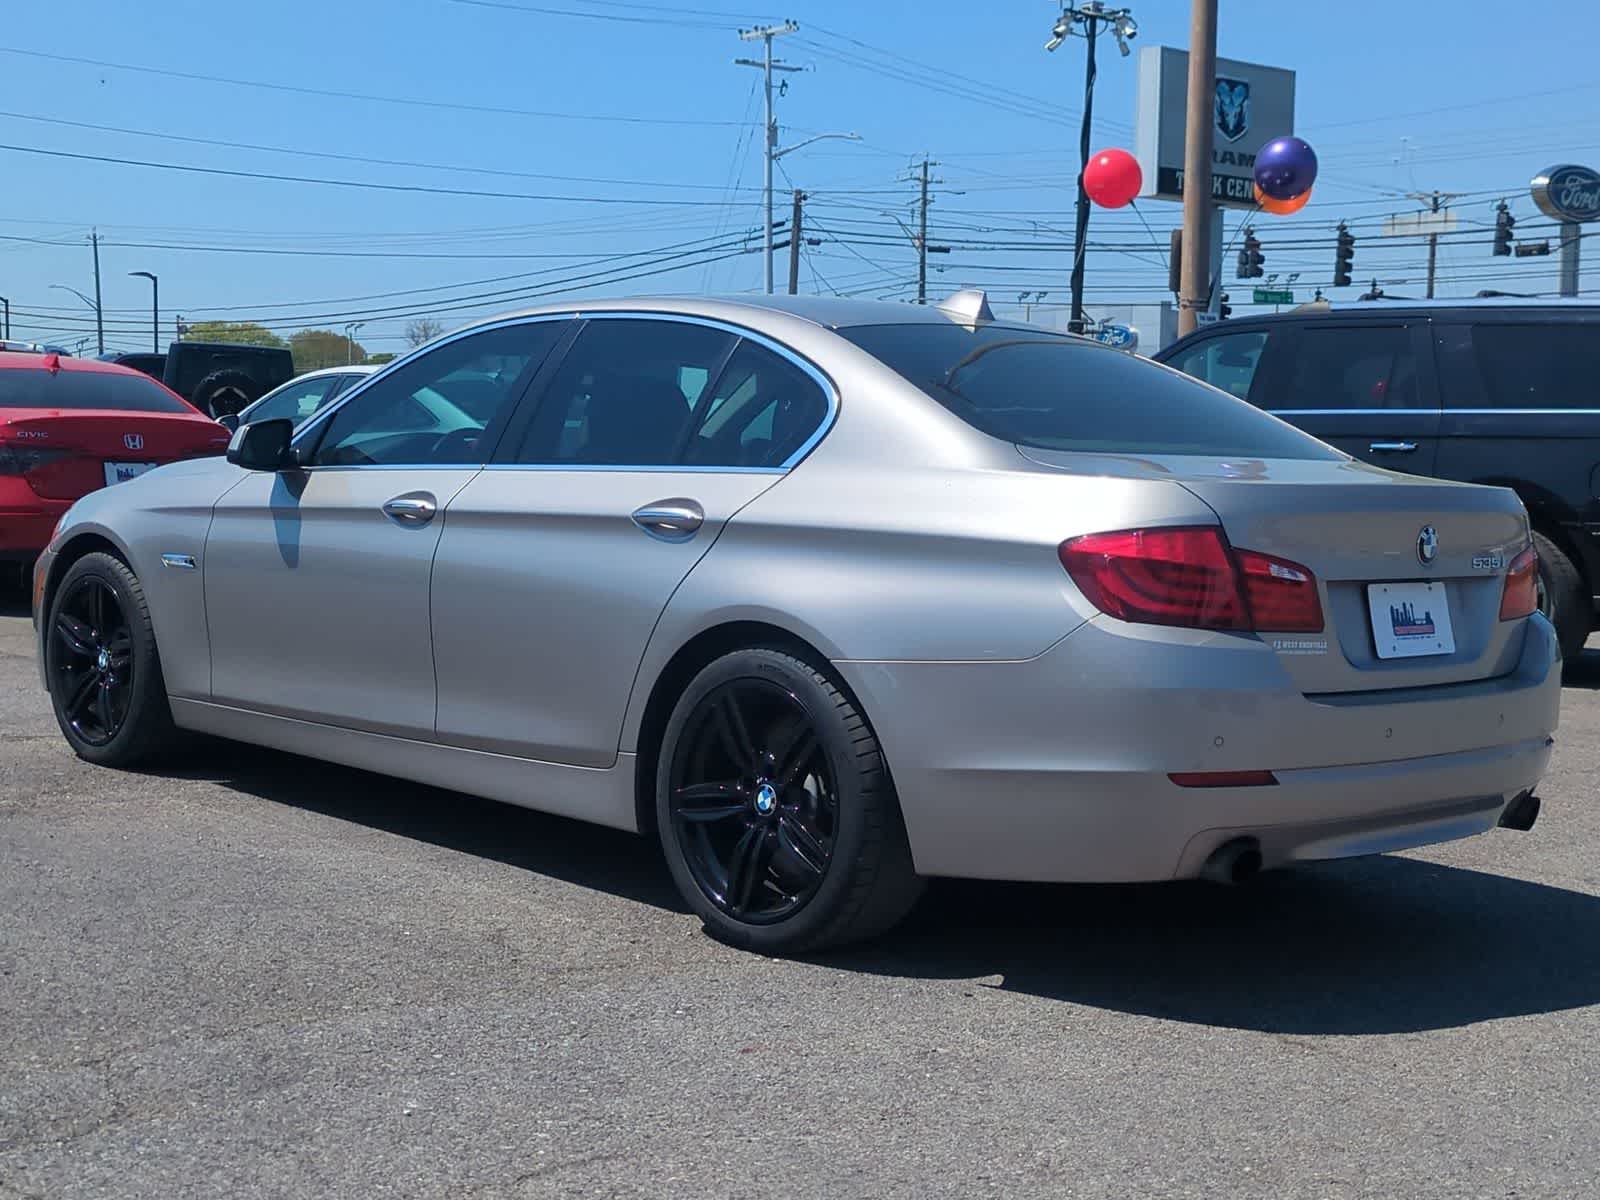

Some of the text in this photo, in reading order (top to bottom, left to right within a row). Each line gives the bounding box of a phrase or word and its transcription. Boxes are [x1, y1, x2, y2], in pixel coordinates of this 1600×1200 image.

[1212, 150, 1257, 169] AM
[1227, 178, 1253, 199] CEN
[1561, 175, 1600, 209] Ford
[16, 431, 49, 439] CIVIC
